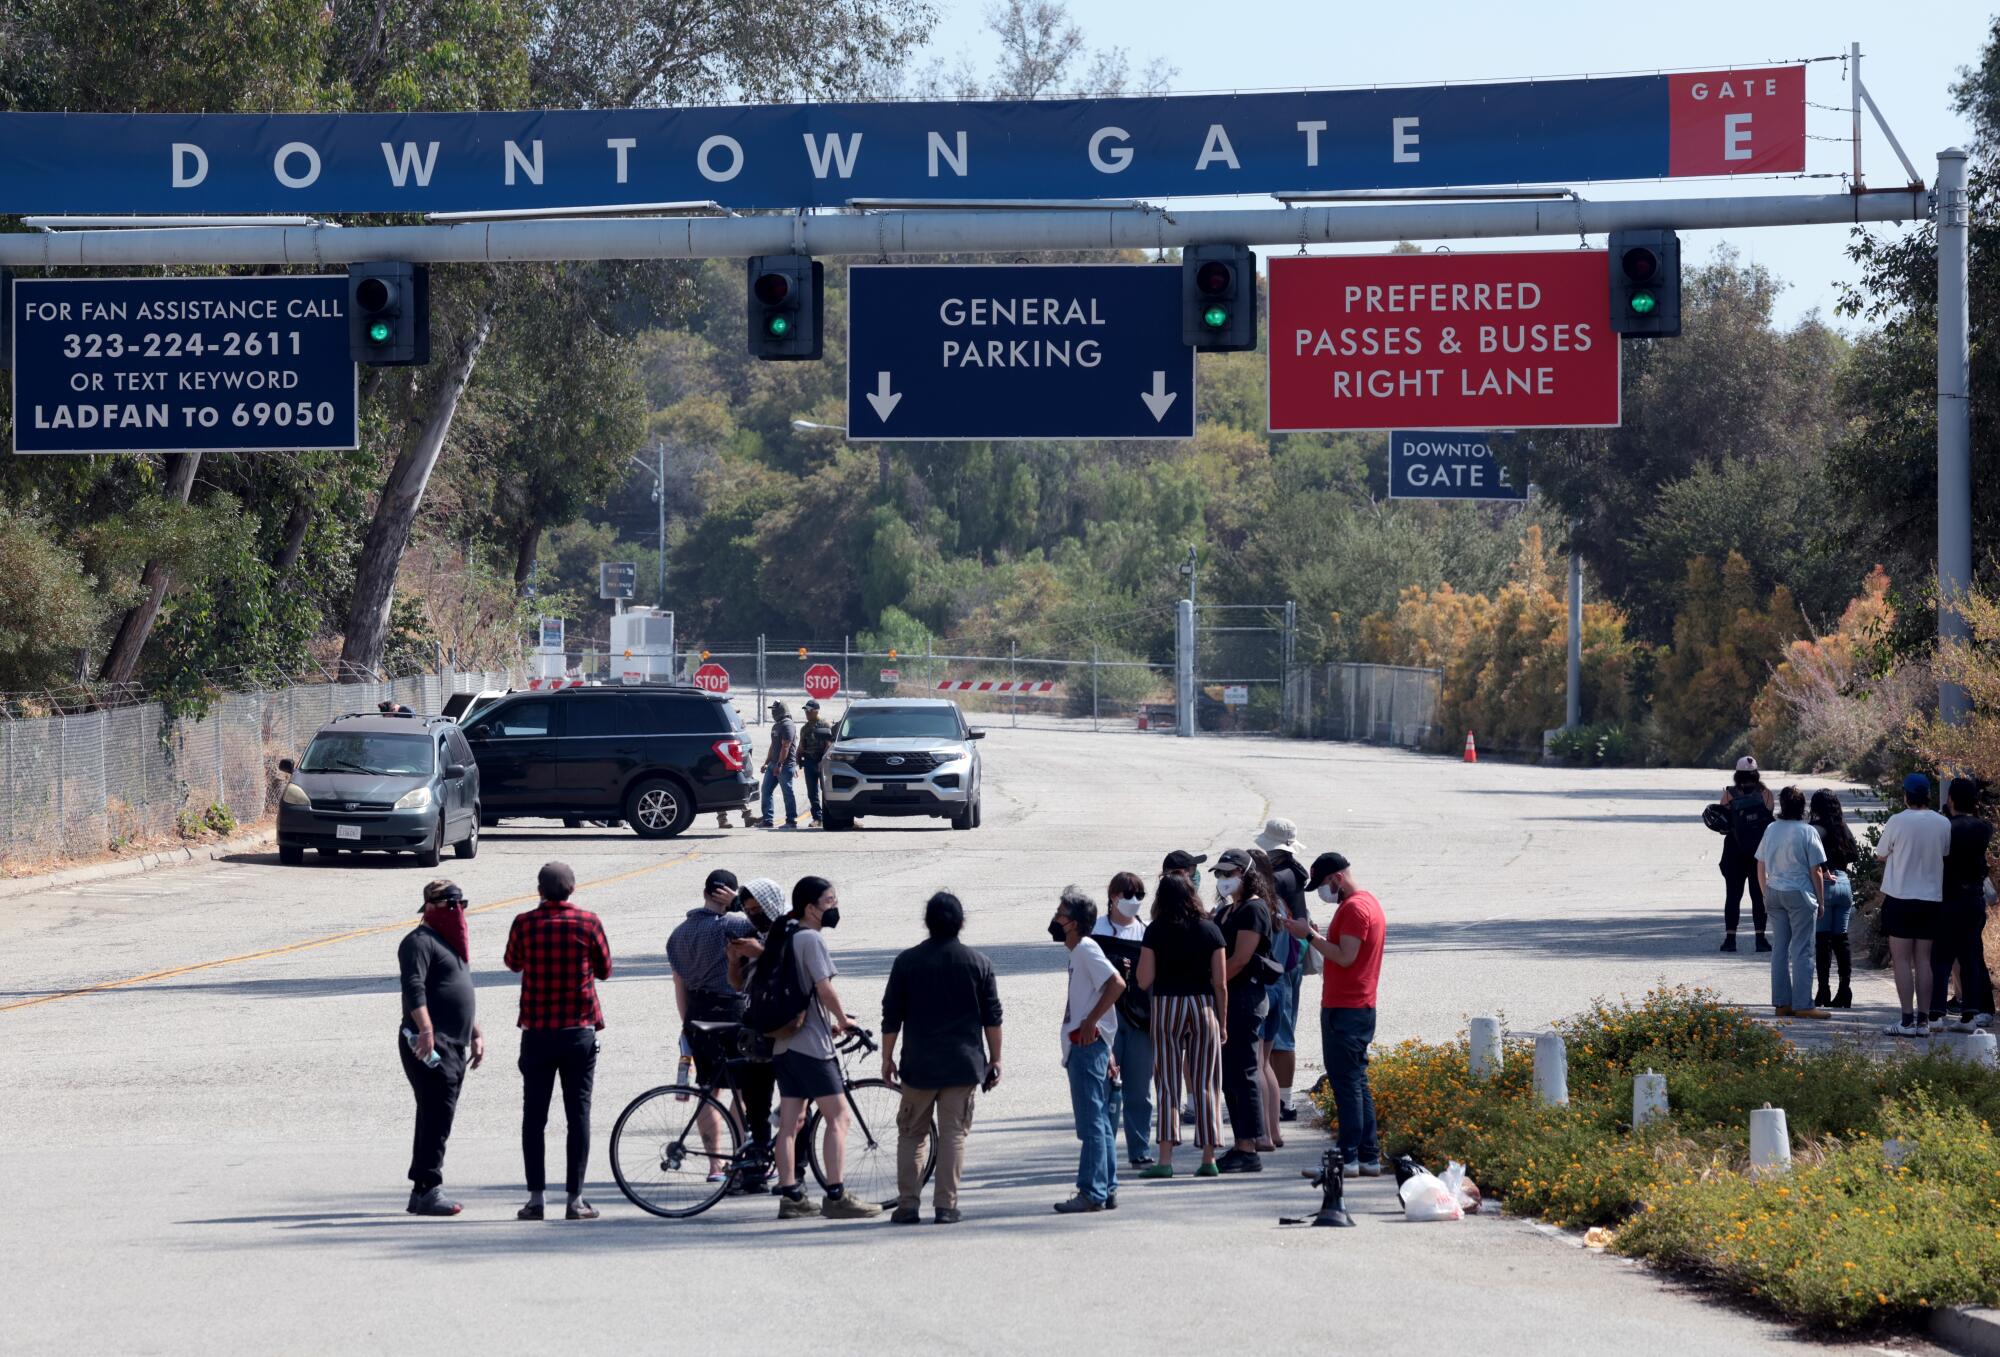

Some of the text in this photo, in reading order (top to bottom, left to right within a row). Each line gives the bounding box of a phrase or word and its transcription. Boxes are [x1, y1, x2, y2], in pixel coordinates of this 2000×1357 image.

[1691, 79, 1777, 100] GATE
[1724, 112, 1754, 161] E
[172, 117, 1420, 189] DOWNTOWN GATE
[26, 299, 344, 321] FOR FAN ASSISTANCE CALL
[1345, 282, 1541, 313] PREFERRED
[938, 298, 1106, 326] GENERAL
[63, 331, 300, 359] 323-224-2611
[943, 339, 1102, 368] PARKING
[1296, 323, 1592, 356] PASSES & BUSES
[70, 370, 298, 392] OR TEXT KEYWORD
[1334, 367, 1554, 398] RIGHT LANE
[35, 403, 169, 429] LADFAN
[231, 401, 335, 427] 69050
[1403, 442, 1494, 458] DOWNTO
[1407, 463, 1484, 487] GATE
[695, 675, 728, 690] STOP
[806, 675, 839, 690] STOP
